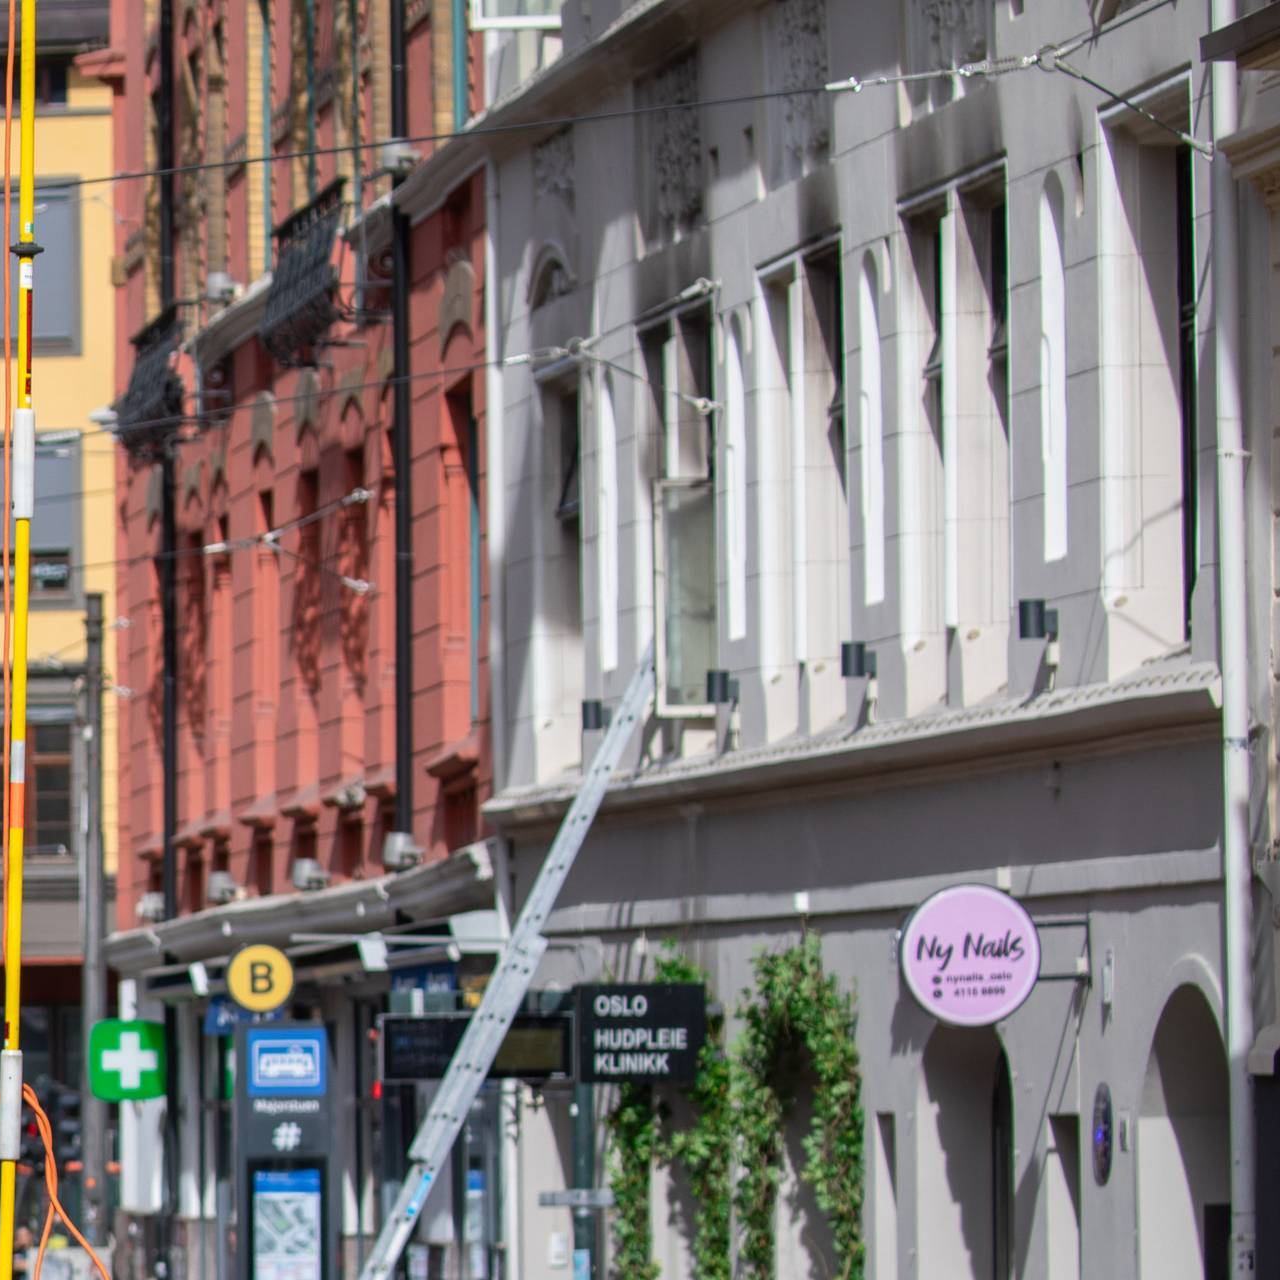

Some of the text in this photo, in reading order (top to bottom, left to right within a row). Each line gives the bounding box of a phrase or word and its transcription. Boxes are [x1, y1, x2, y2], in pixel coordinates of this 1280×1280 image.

[916, 929, 1025, 972] Ny Nails
[250, 963, 273, 993] B
[595, 995, 648, 1017] OSLO
[594, 1028, 688, 1050] HUDPLEIE
[594, 1053, 670, 1074] KLINIKK
